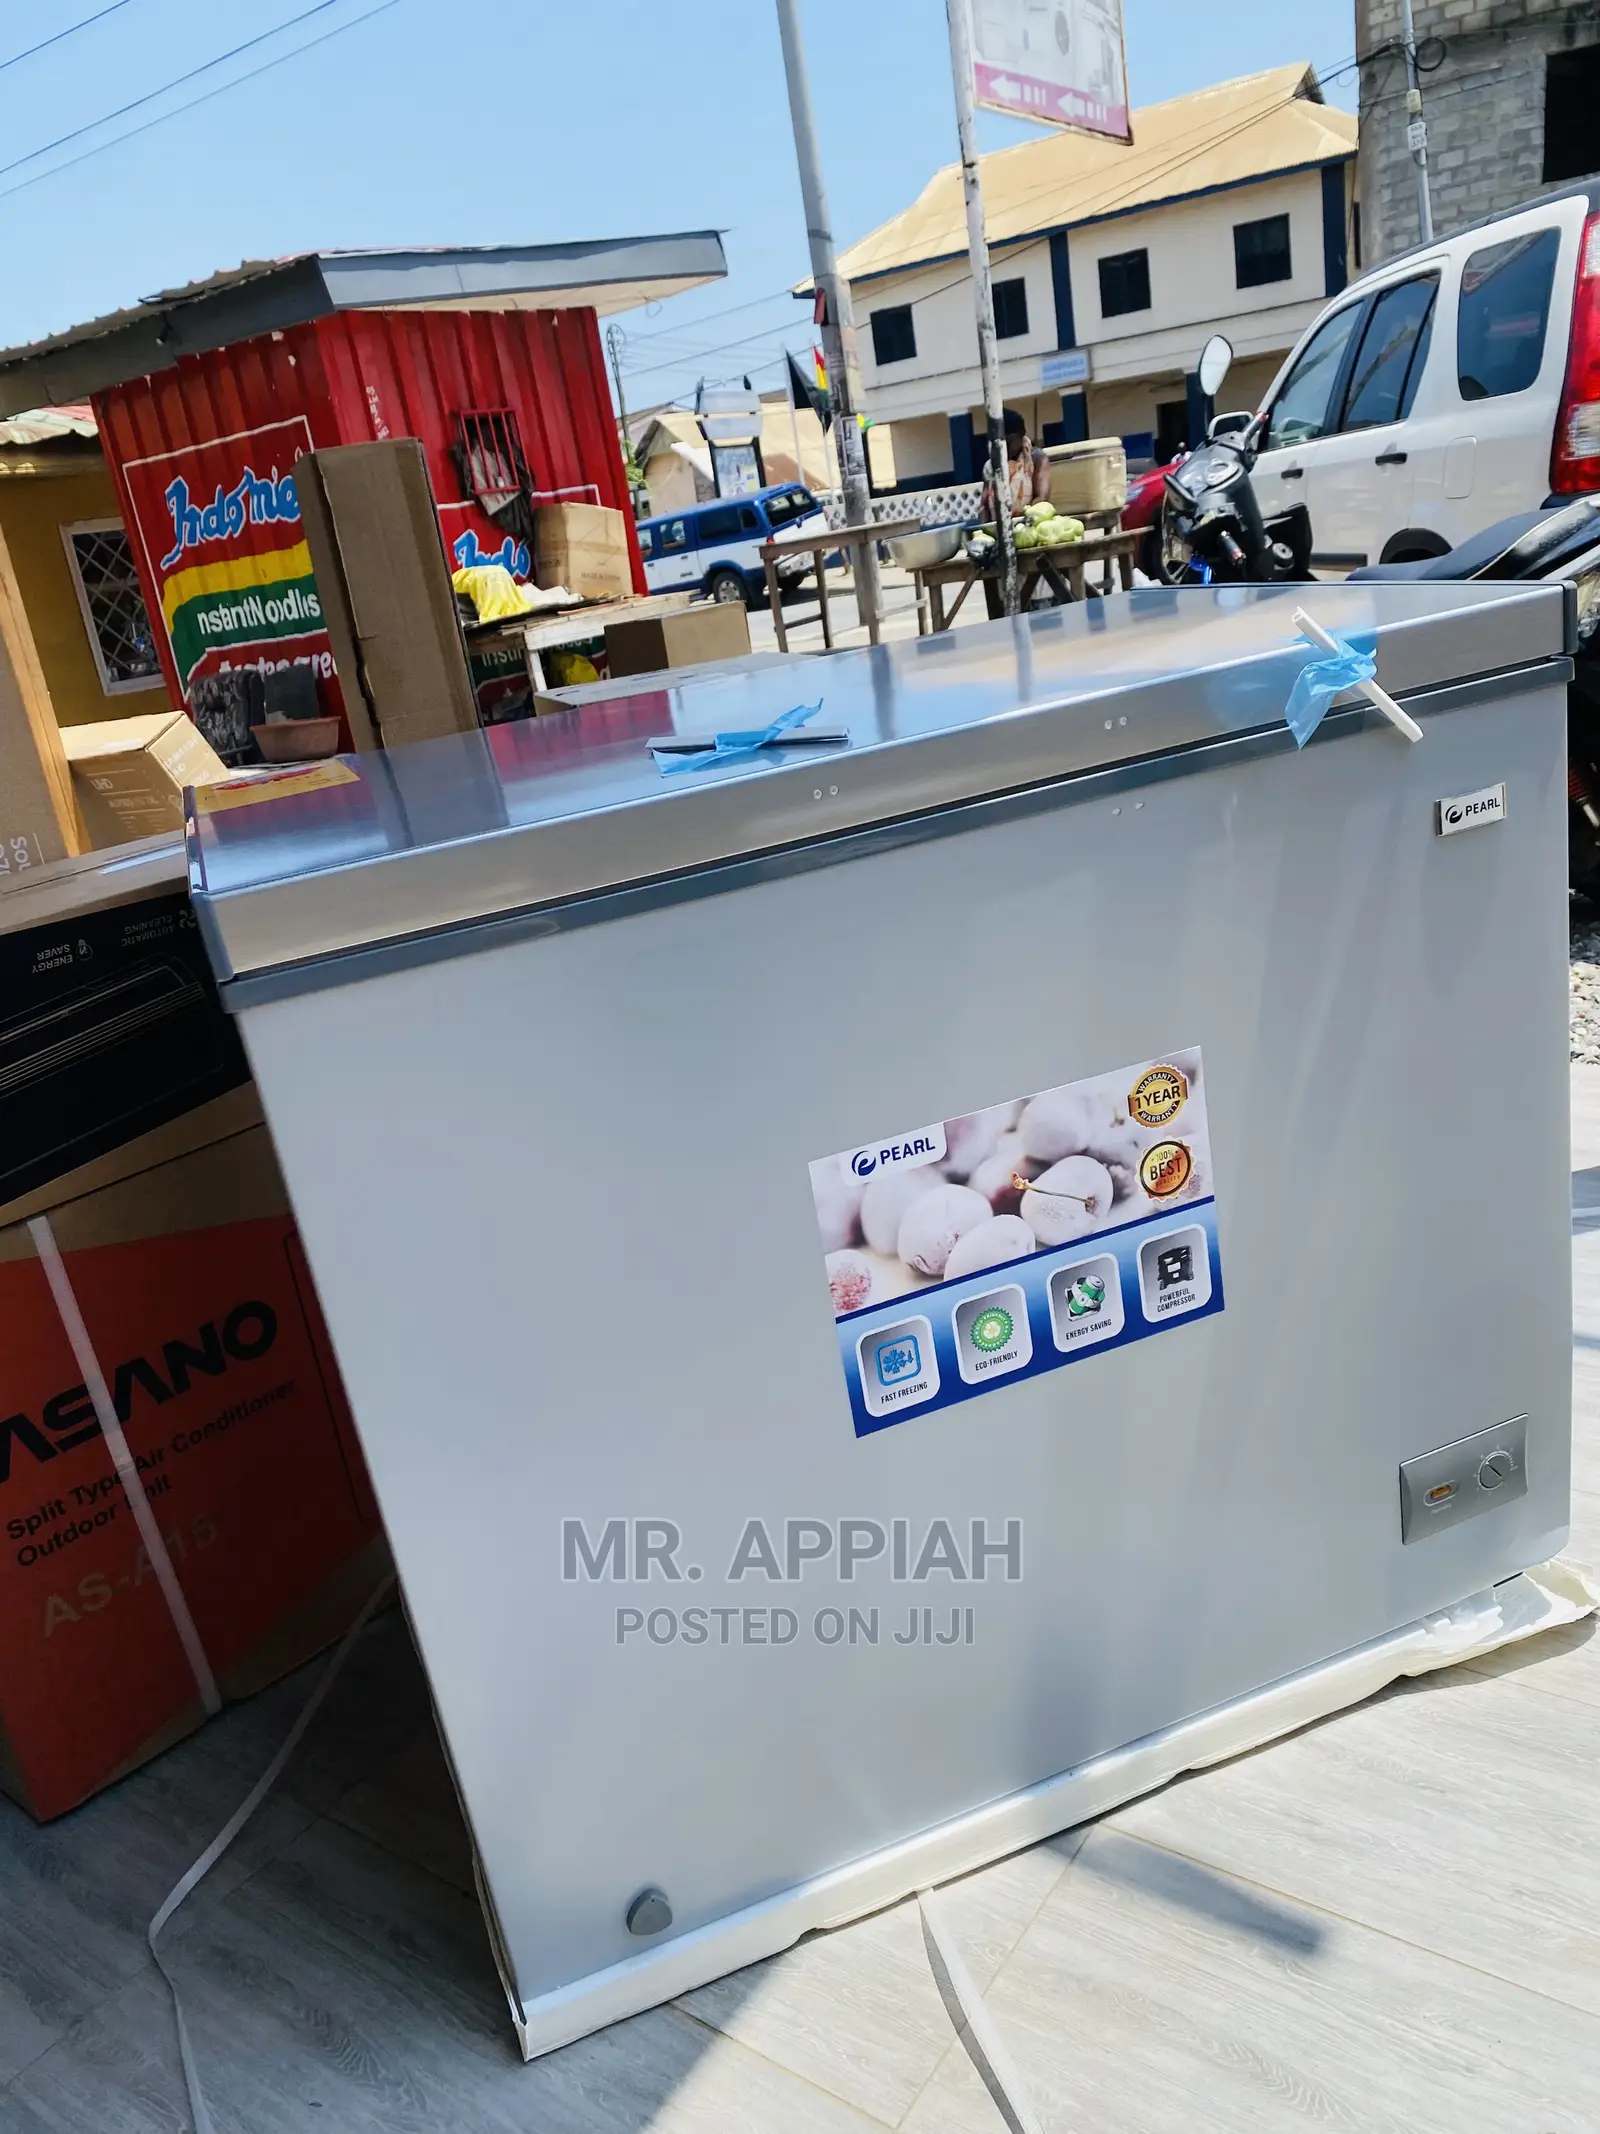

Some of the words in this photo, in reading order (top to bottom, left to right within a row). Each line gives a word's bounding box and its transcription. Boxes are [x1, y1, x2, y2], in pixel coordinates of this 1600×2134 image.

[160, 465, 301, 571] Indomie
[1465, 797, 1501, 817] PEARL
[124, 915, 172, 935] CLEANING
[121, 925, 174, 947] AUTOMATIC
[36, 944, 71, 961] SAVER
[32, 954, 74, 974] ENERGY
[1138, 1072, 1176, 1092] WARRANTY
[1143, 1085, 1181, 1107] YEAR
[1140, 1102, 1178, 1122] WARRANTY
[880, 1137, 936, 1165] PEARL
[1150, 1157, 1182, 1181] BEST
[1157, 1294, 1196, 1312] COMPRESSOR
[1159, 1288, 1190, 1303] POWERFUL
[1065, 1326, 1089, 1340] ENERGY
[1089, 1319, 1112, 1331] SAVING
[975, 1350, 1018, 1371] ECO-FRIENDLY
[881, 1392, 897, 1404] FAST
[898, 1381, 928, 1398] FREEZING
[6, 1495, 67, 1541] Split
[136, 1446, 166, 1475] Air
[172, 1379, 296, 1455] Conditioner
[17, 1503, 119, 1567] Outdoor
[125, 1471, 173, 1512] nit
